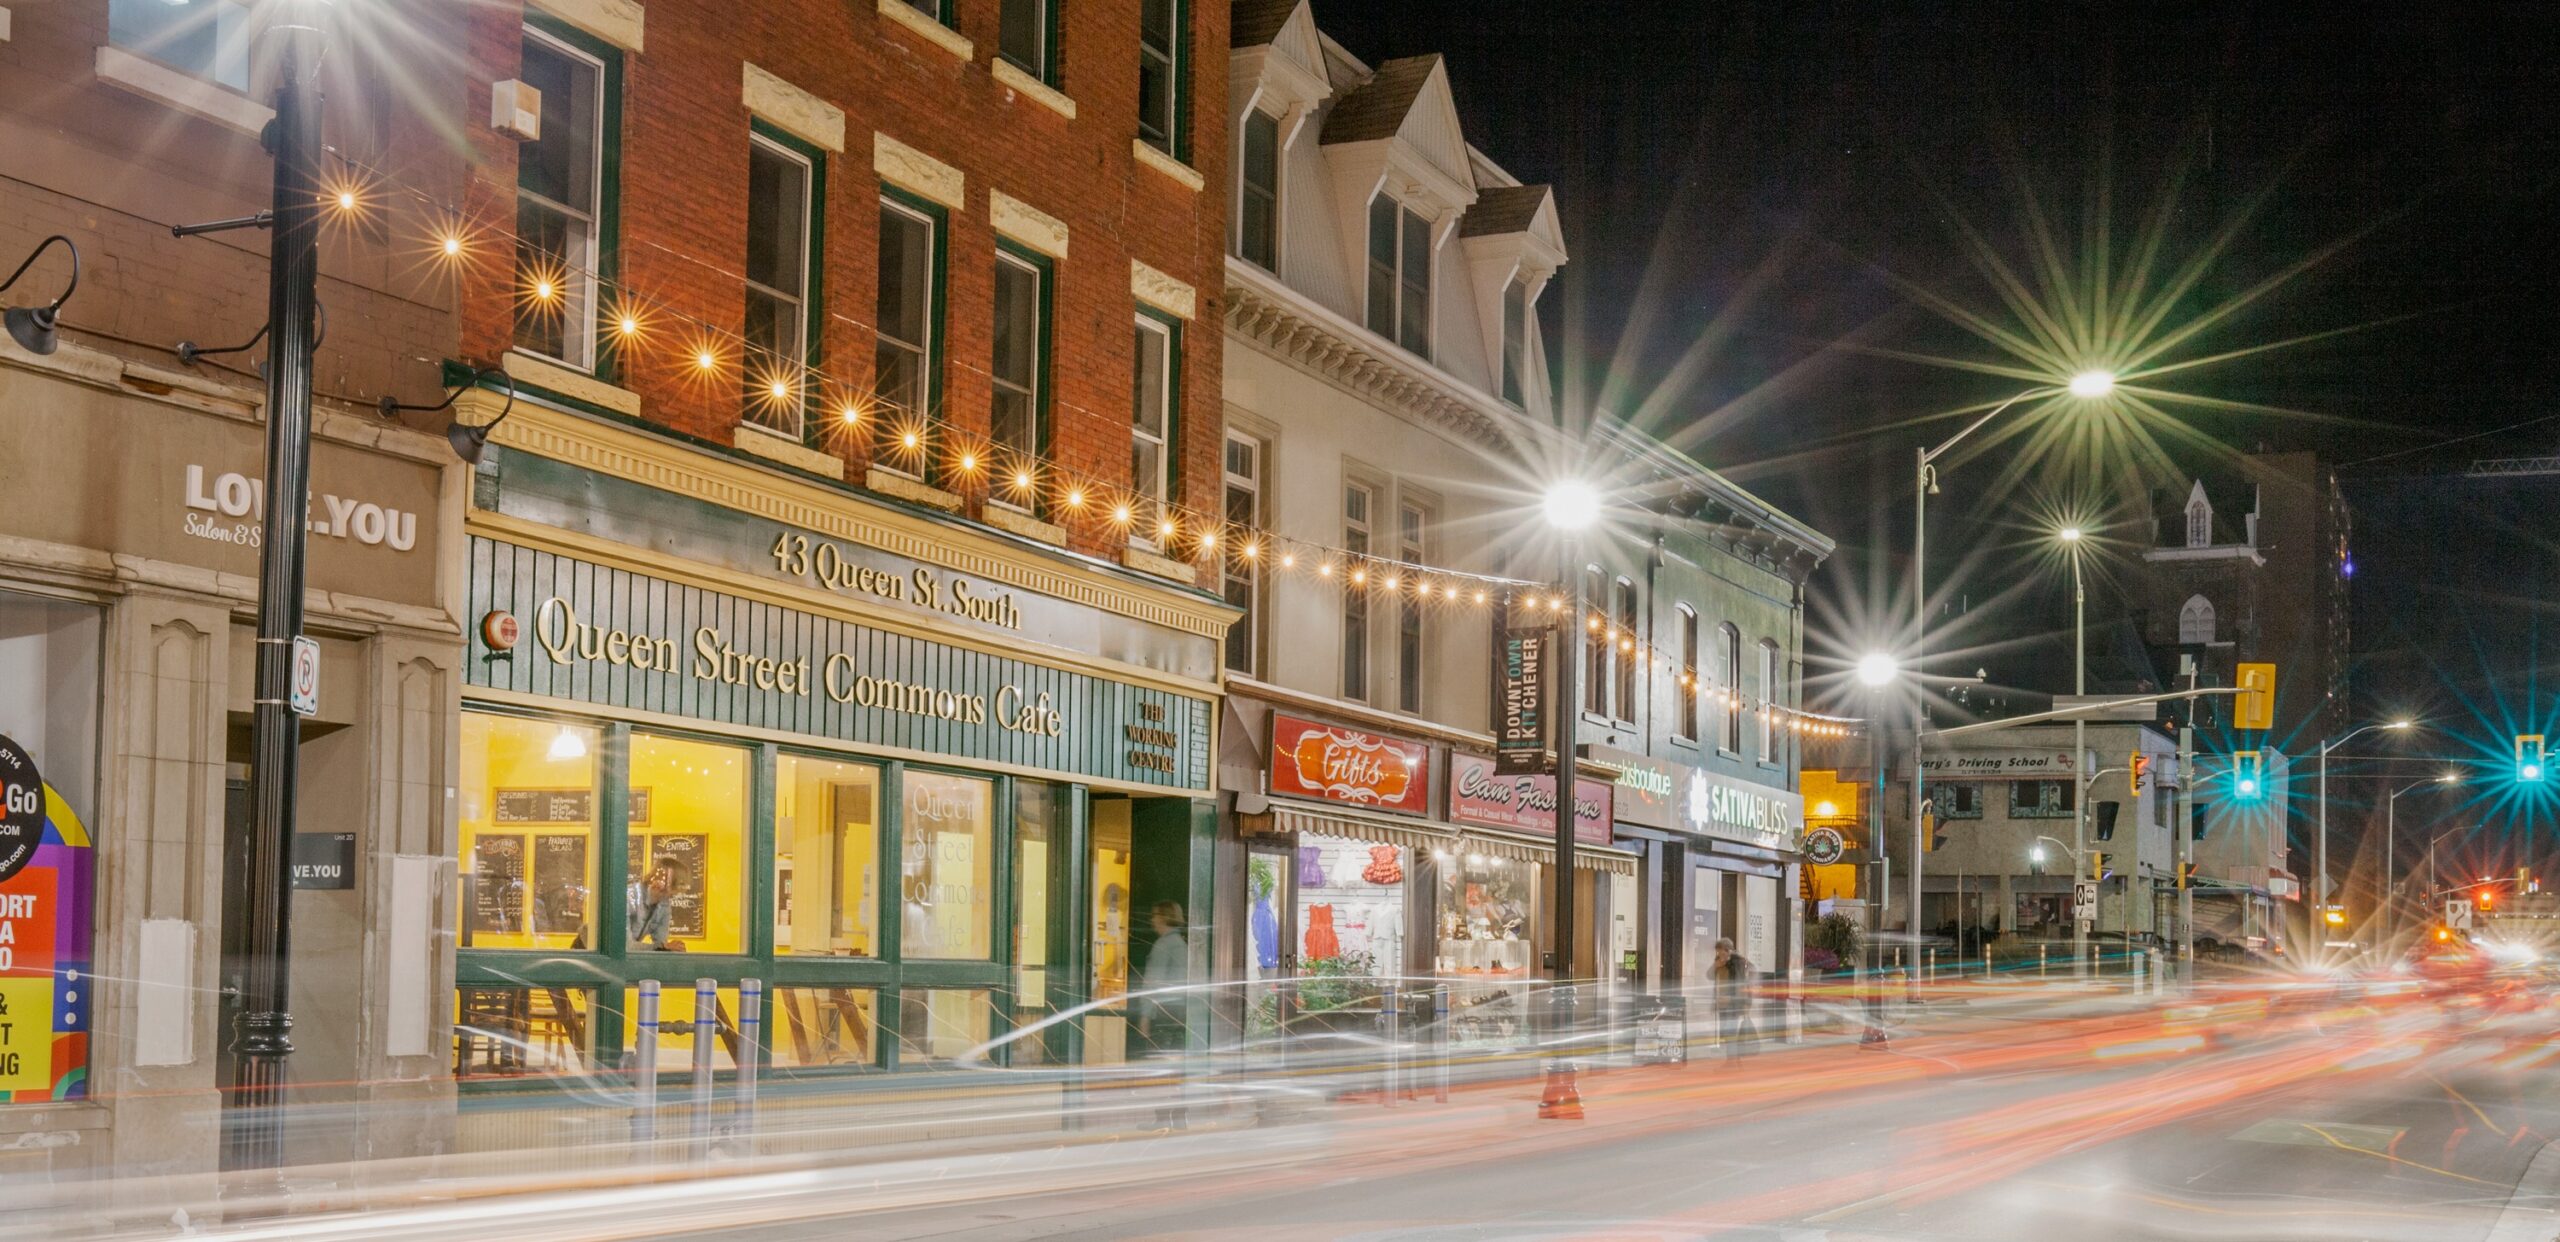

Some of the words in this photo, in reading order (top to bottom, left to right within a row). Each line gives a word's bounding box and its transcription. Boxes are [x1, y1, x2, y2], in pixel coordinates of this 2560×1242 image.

[185, 464, 416, 551] LOV.YOU
[184, 512, 232, 543] Salon
[233, 524, 249, 545] &
[773, 532, 809, 576] 43
[816, 543, 905, 601] Queen
[913, 568, 950, 612] St.
[953, 579, 1022, 630] South
[536, 597, 680, 666] Queen
[694, 627, 810, 697] Street
[826, 653, 985, 725] Commons
[996, 685, 1062, 737] Cafe
[1507, 641, 1521, 739] DOWNTOWN
[1522, 638, 1537, 738] KITCHENER
[1139, 702, 1165, 723] THE
[1126, 724, 1177, 750] WORKING
[1129, 750, 1175, 775] CENTRE
[1323, 743, 1384, 785] Gifts
[1595, 759, 1671, 799] bisboutique
[1920, 759, 1951, 770] ary's
[1958, 758, 2002, 769] Driving
[2008, 757, 2049, 767] School
[912, 784, 976, 822] Queen
[1458, 764, 1512, 805] Cam
[1460, 805, 1478, 816] Formal
[1484, 809, 1500, 820] Casual
[1712, 785, 1788, 835] SATIVABLISS
[912, 828, 974, 864] Street
[293, 864, 341, 878] VE.YOU
